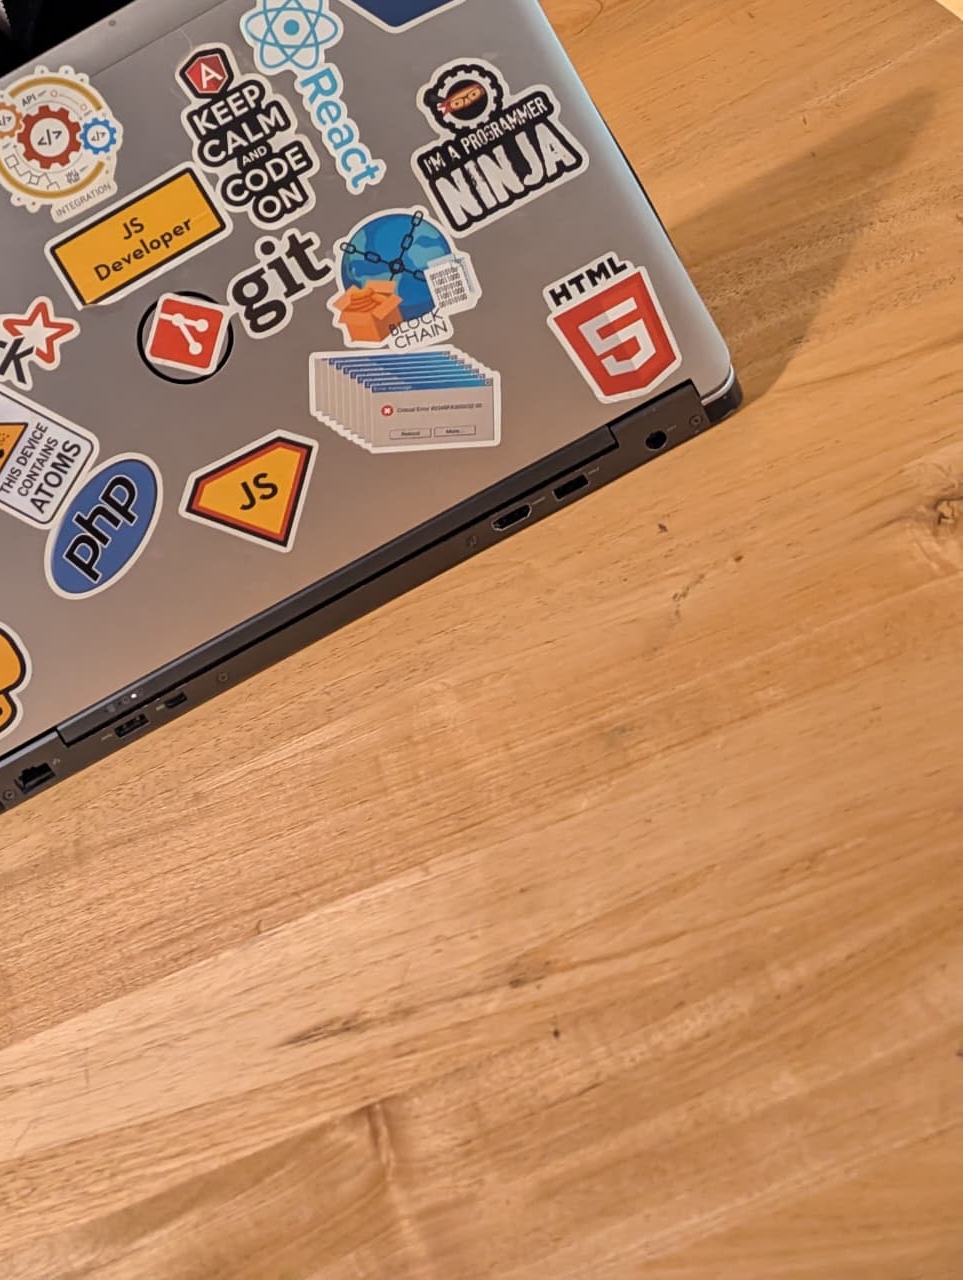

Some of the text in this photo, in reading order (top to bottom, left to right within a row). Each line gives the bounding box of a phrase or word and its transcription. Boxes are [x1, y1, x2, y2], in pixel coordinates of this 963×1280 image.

[21, 93, 37, 107] API
[193, 84, 260, 136] KEEP
[203, 106, 285, 163] CALM
[300, 67, 380, 189] React
[423, 97, 548, 175] I'M A PROGRAMMER
[226, 146, 307, 202] CODE
[242, 145, 268, 167] AND
[435, 123, 577, 226] NINJA
[55, 183, 112, 217] INTEGRATION
[258, 182, 303, 218] ON
[93, 218, 192, 281] Developer
[123, 217, 145, 240] JS
[232, 233, 332, 333] git
[549, 257, 628, 307] HTML
[389, 308, 444, 337] BLOCK
[394, 321, 448, 349] CHAIN
[578, 297, 657, 377] 5
[16, 422, 48, 466] DEVICE
[17, 437, 59, 497] CONTAINS
[29, 440, 82, 514] ATOMS
[239, 472, 278, 511] JS
[63, 474, 138, 583] php
